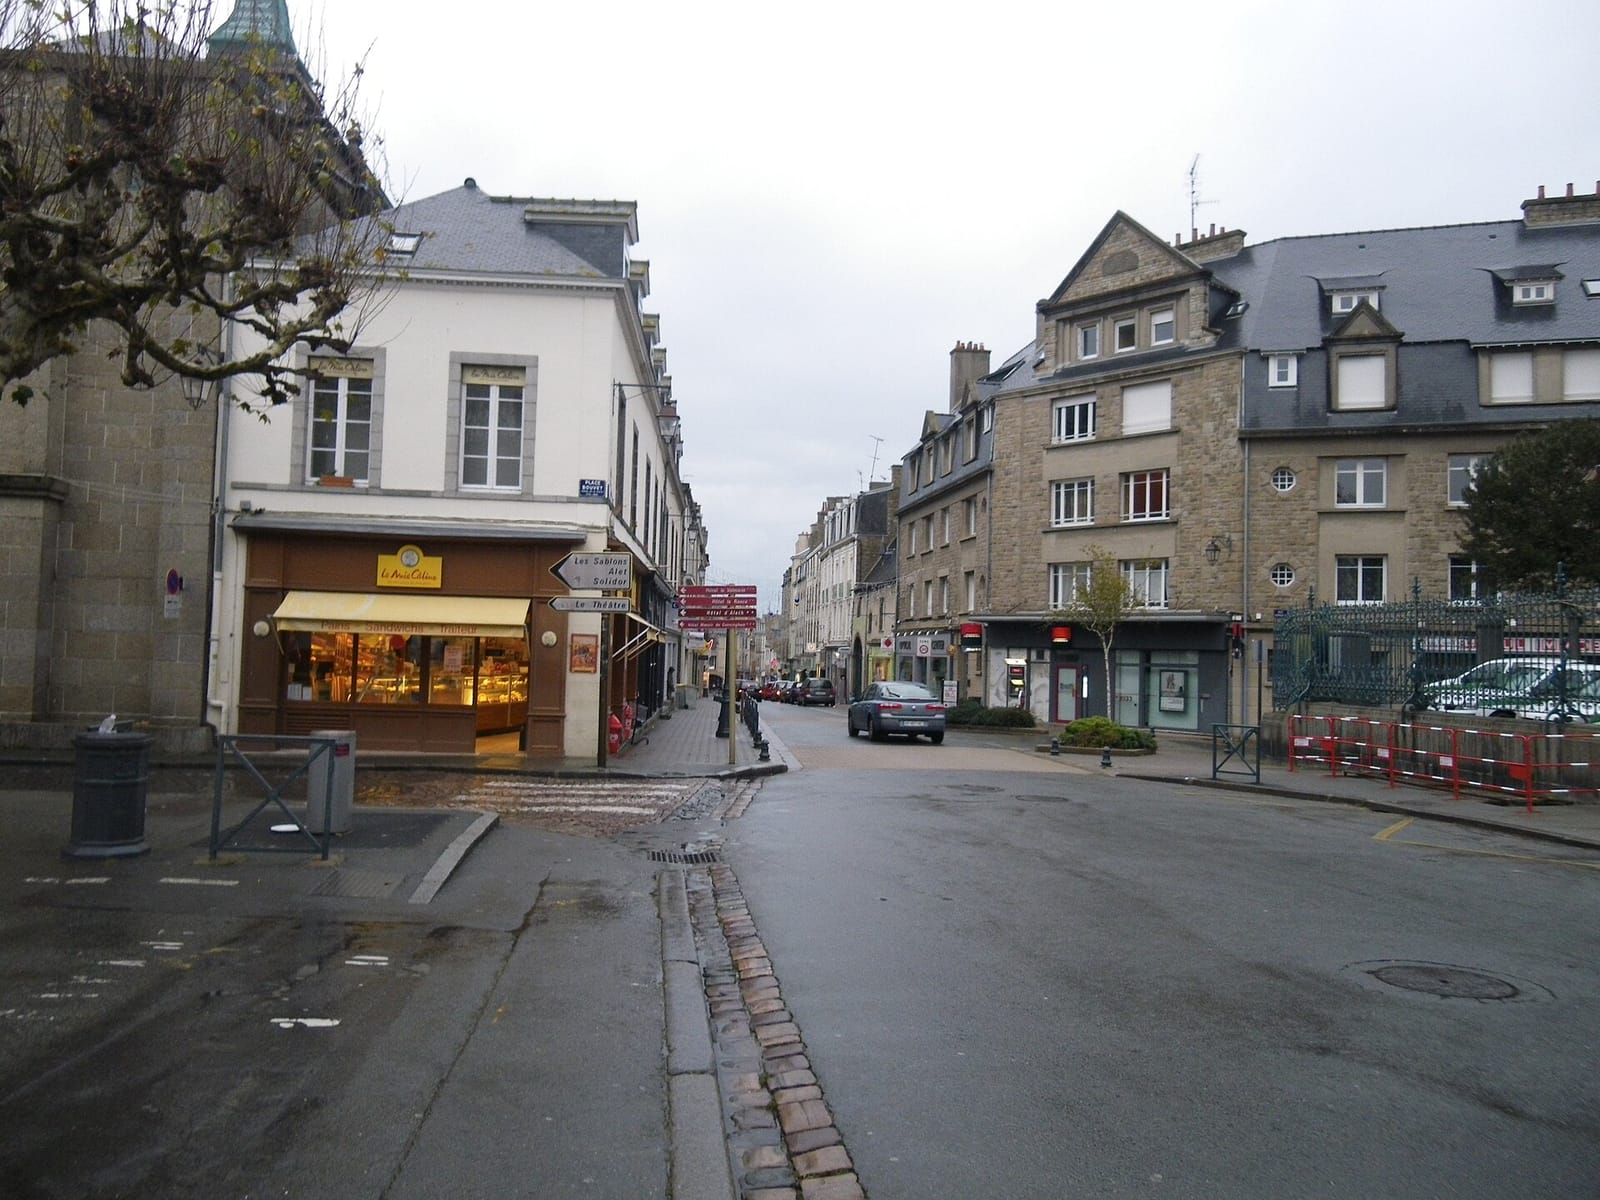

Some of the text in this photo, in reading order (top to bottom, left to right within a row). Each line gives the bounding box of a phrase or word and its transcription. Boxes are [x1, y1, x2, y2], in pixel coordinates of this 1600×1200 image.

[574, 557, 628, 566] Les Sablons
[608, 567, 627, 576] Alet
[592, 577, 628, 586] Solidor
[575, 600, 627, 609] Le Théâtre
